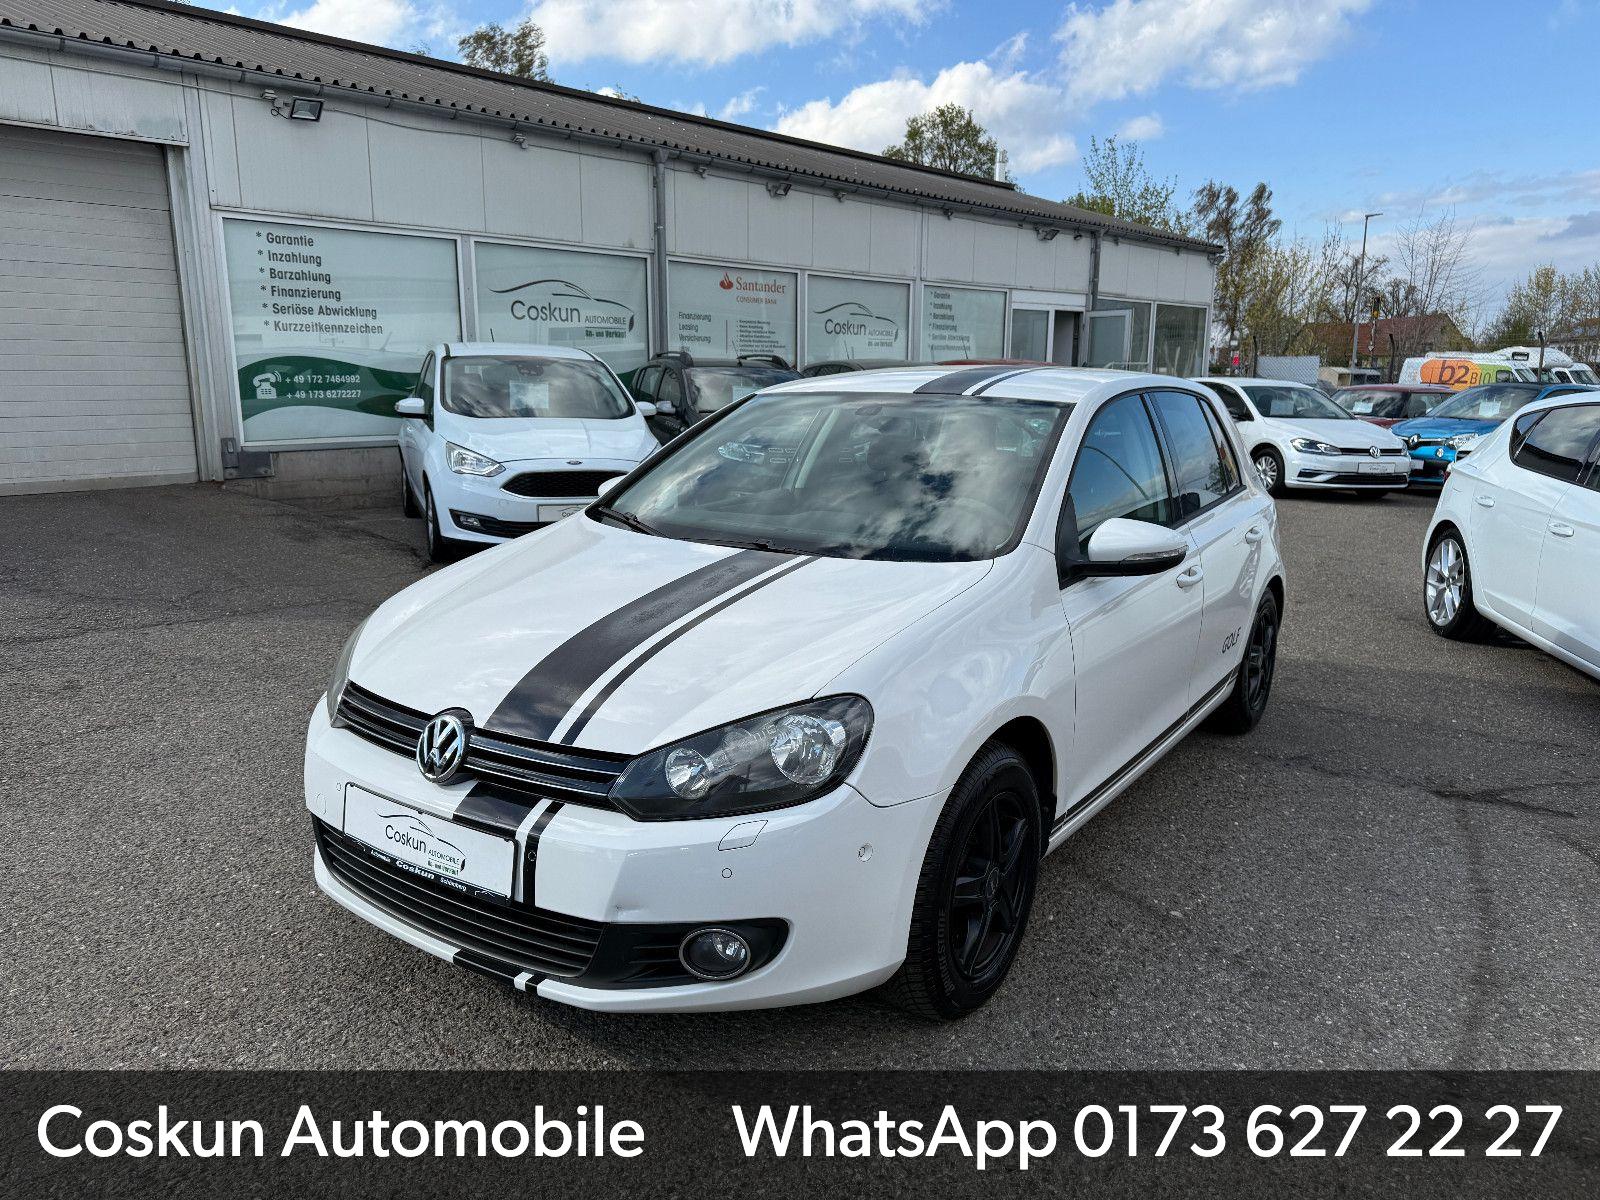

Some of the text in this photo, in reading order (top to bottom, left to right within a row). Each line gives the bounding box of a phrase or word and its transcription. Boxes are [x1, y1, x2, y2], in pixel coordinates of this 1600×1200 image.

[266, 232, 314, 247] Garantie
[268, 250, 322, 267] Inzahlung
[269, 268, 331, 285] Barzahlung
[736, 276, 786, 294] Santander
[271, 285, 341, 301] Finanzierung
[272, 303, 377, 320] Seriöse Abwicklung
[511, 300, 581, 323] Coskun
[585, 315, 626, 325] AUTOMOBILE
[274, 320, 383, 335] Kurzzeitkennzeichen
[824, 318, 867, 336] Coskun
[307, 375, 323, 383] 172
[325, 375, 361, 383] 7464992
[1438, 360, 1470, 384] b2
[309, 390, 324, 398] 173
[326, 390, 361, 398] 6272227
[1222, 626, 1241, 653] GOLF
[385, 824, 427, 854] Coskun
[396, 860, 435, 880] Coskun
